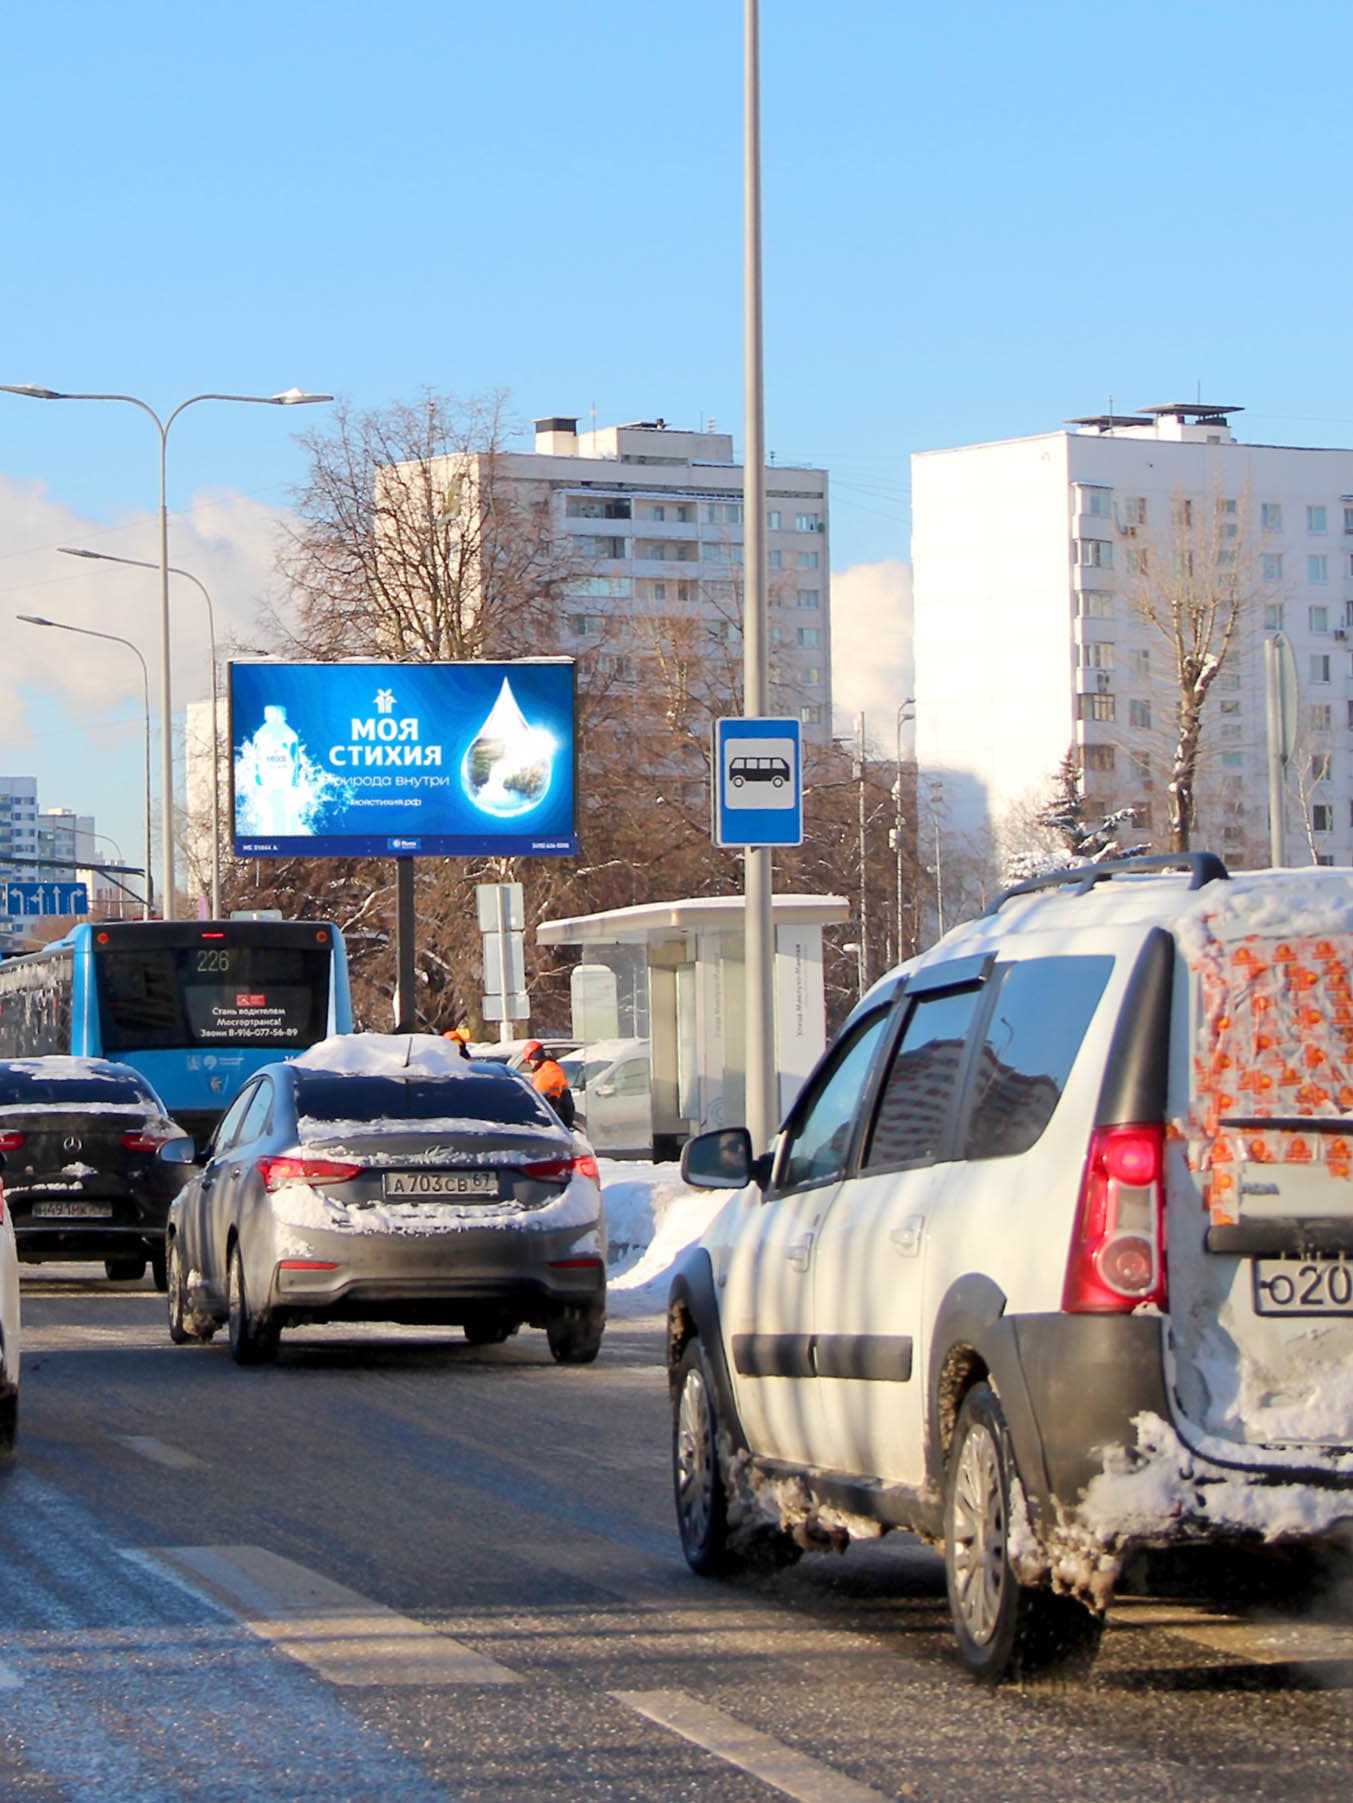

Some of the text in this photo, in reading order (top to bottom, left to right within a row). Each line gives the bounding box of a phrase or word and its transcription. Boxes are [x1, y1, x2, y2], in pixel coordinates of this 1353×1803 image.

[351, 718, 419, 742] МОЯ
[329, 745, 442, 766] СТИХИЯ
[324, 775, 450, 788] рирода внутри
[197, 950, 230, 972] 226
[211, 1007, 286, 1016] Стань водителем
[200, 1029, 228, 1038] Звони
